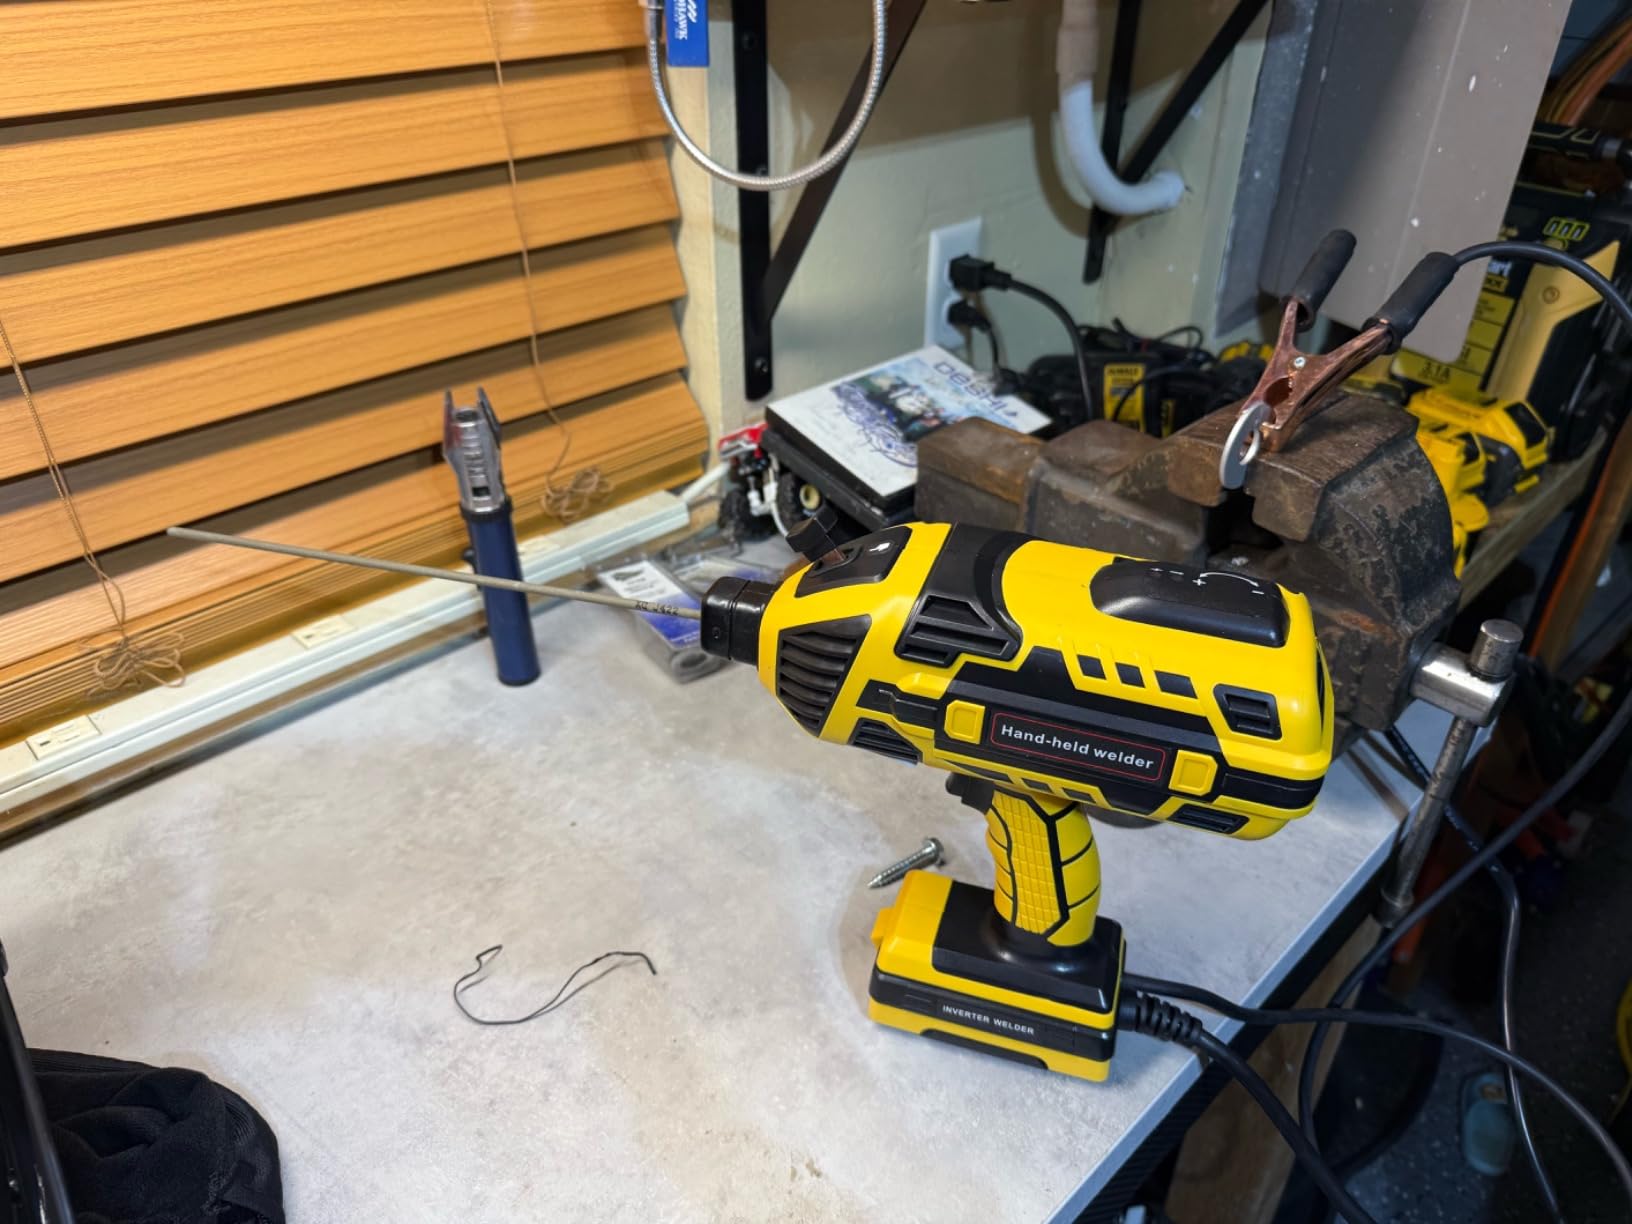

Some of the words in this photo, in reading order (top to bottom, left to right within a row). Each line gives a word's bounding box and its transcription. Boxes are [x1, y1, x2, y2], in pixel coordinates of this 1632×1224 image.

[1000, 723, 1090, 755] Hand-held
[1093, 747, 1154, 770] welder
[942, 1004, 990, 1024] INVERTER
[993, 1017, 1035, 1035] WELDER
